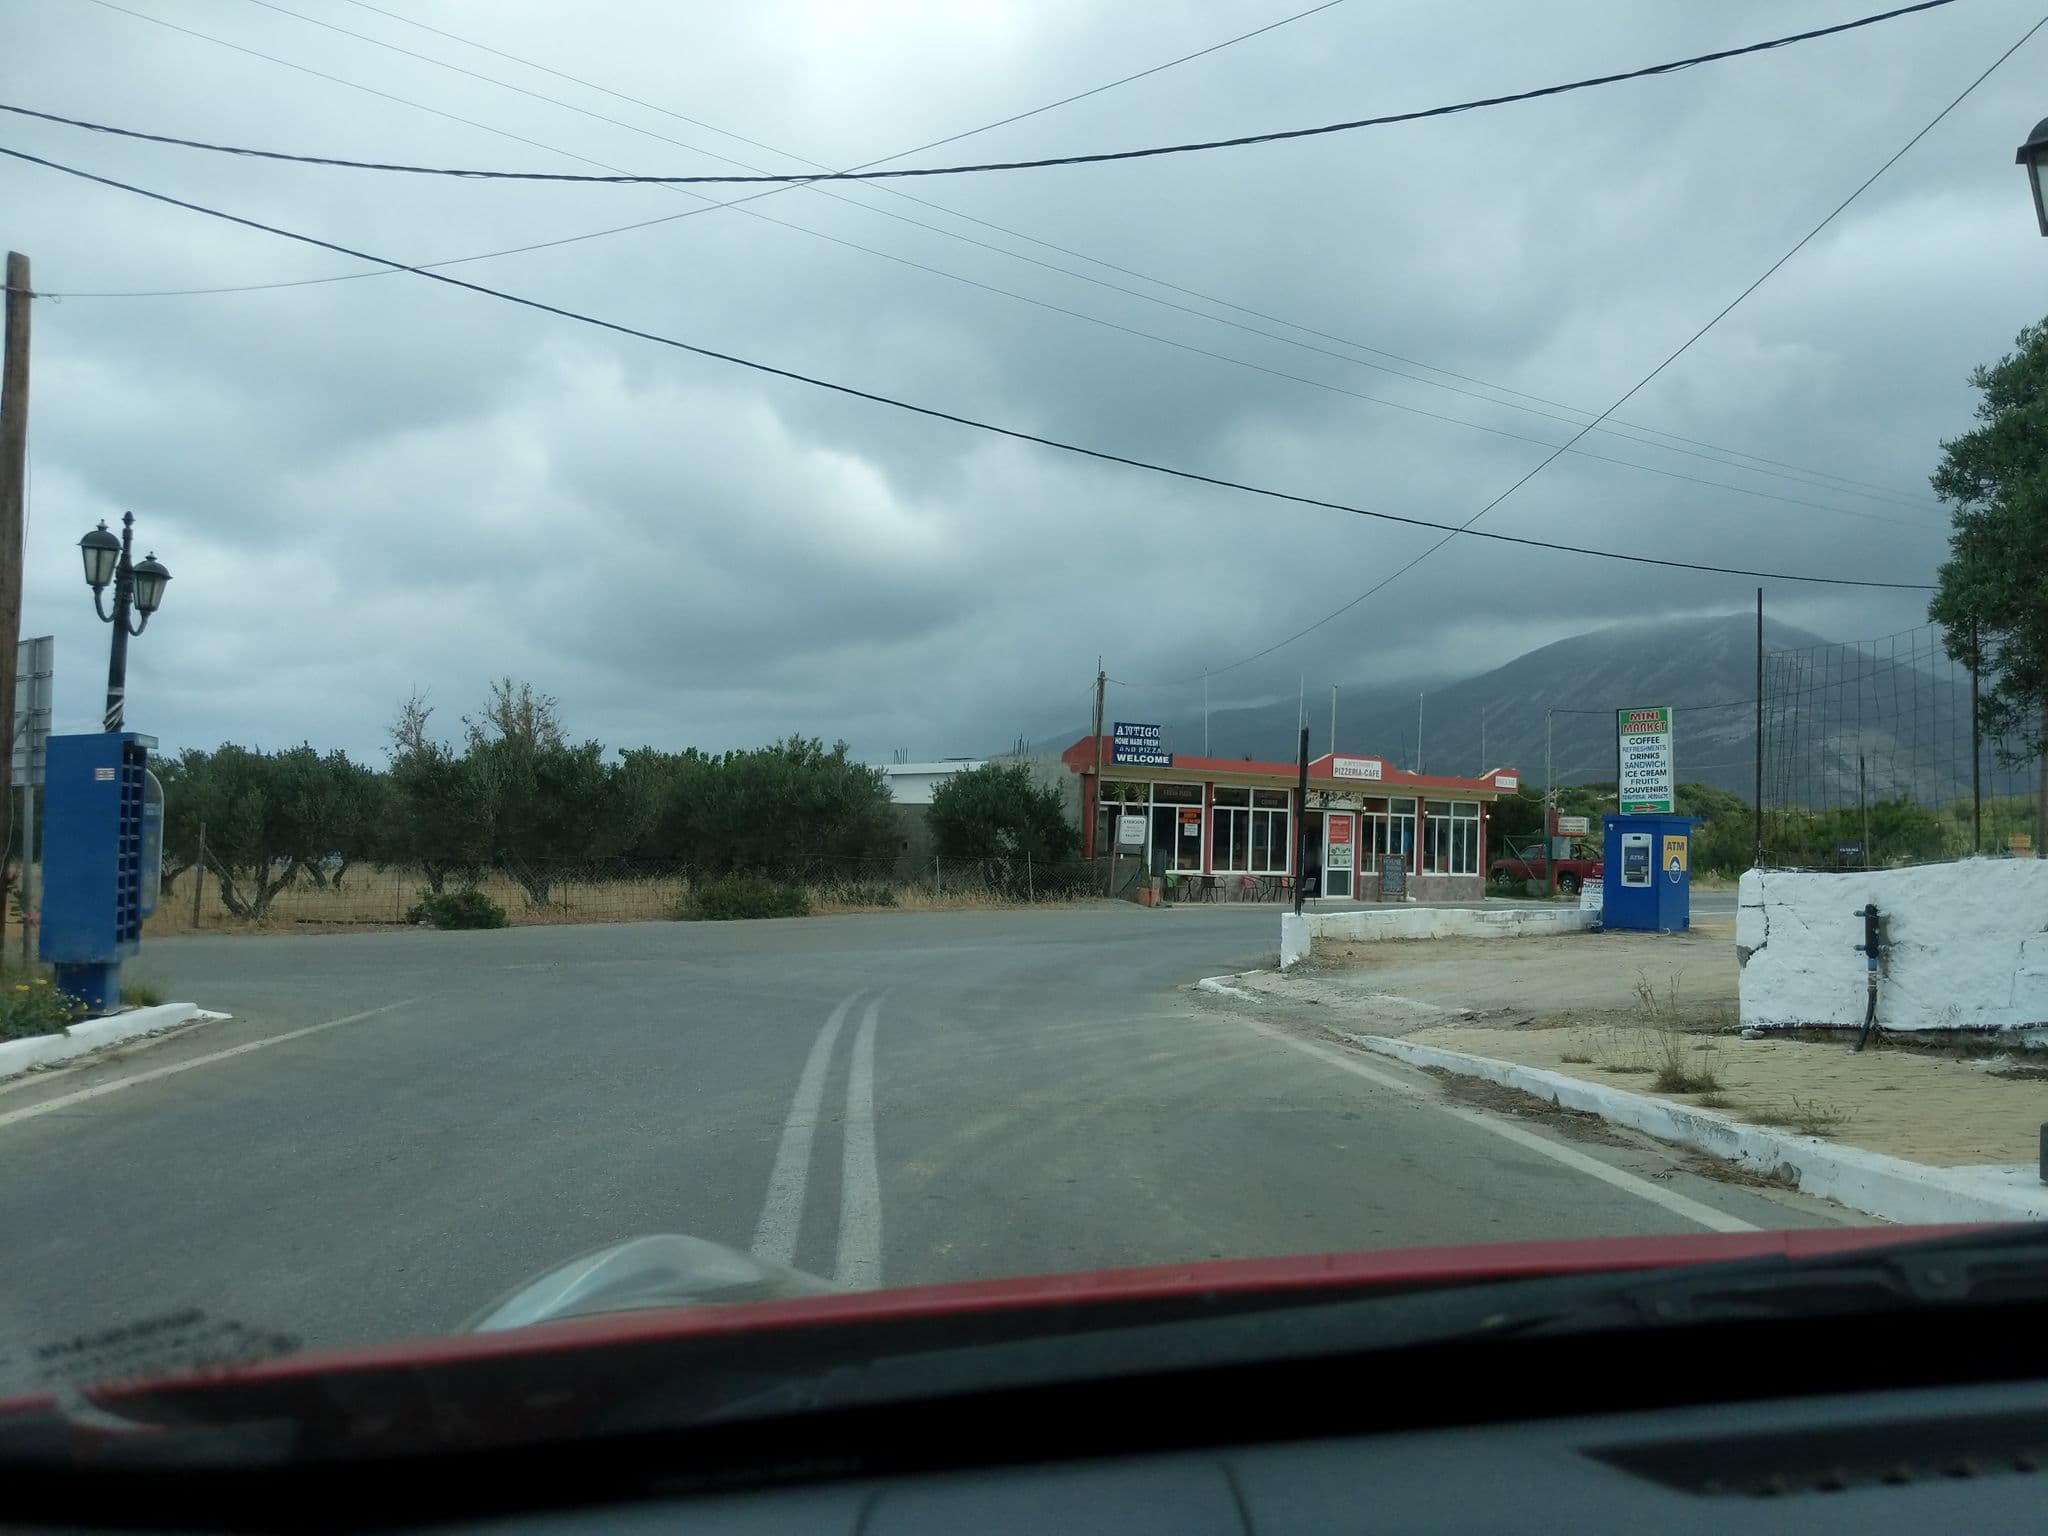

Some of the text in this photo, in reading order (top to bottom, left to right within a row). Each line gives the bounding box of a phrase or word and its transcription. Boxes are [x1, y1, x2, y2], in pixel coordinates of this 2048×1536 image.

[1630, 711, 1658, 720] MINI
[1116, 725, 1160, 737] ANTIGO
[1623, 721, 1665, 732] MARKET
[1629, 736, 1660, 745] COFFEE
[1116, 753, 1170, 764] WELCOME
[1630, 752, 1660, 760] DRINKS
[1624, 760, 1666, 769] SANDWICH
[1624, 768, 1667, 778] ICE CREAM
[1623, 785, 1668, 794] SOUVENIRS
[1667, 841, 1685, 851] ATM
